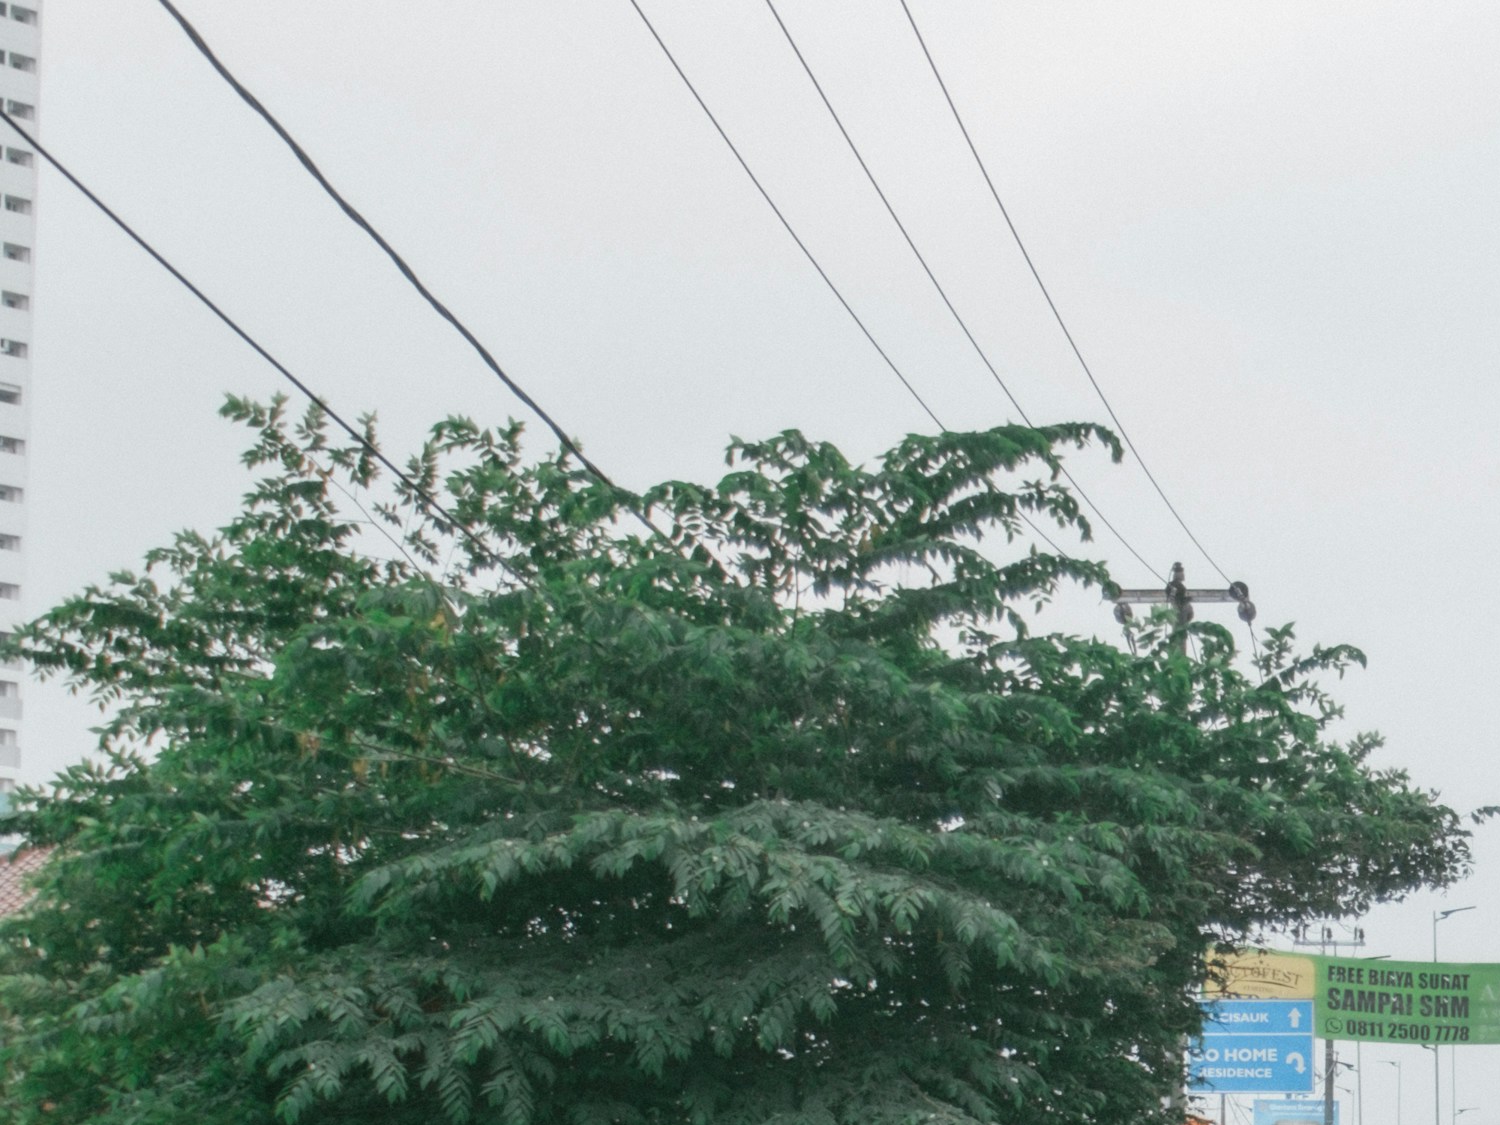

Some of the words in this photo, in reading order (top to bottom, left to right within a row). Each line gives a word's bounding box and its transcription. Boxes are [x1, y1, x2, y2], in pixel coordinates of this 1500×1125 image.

[1327, 965, 1364, 984] FREE
[1369, 969, 1414, 988] BIAYA
[1419, 972, 1471, 991] SURAT
[1327, 987, 1413, 1016] SAMPAI
[1420, 995, 1470, 1019] SHM
[1220, 1012, 1269, 1023] CISAUK
[1346, 1020, 1383, 1037] 0811
[1388, 1023, 1430, 1041] 2500
[1435, 1025, 1470, 1042] 7778
[1224, 1048, 1278, 1062] HOME
[1199, 1067, 1273, 1079] RESIDENCE
